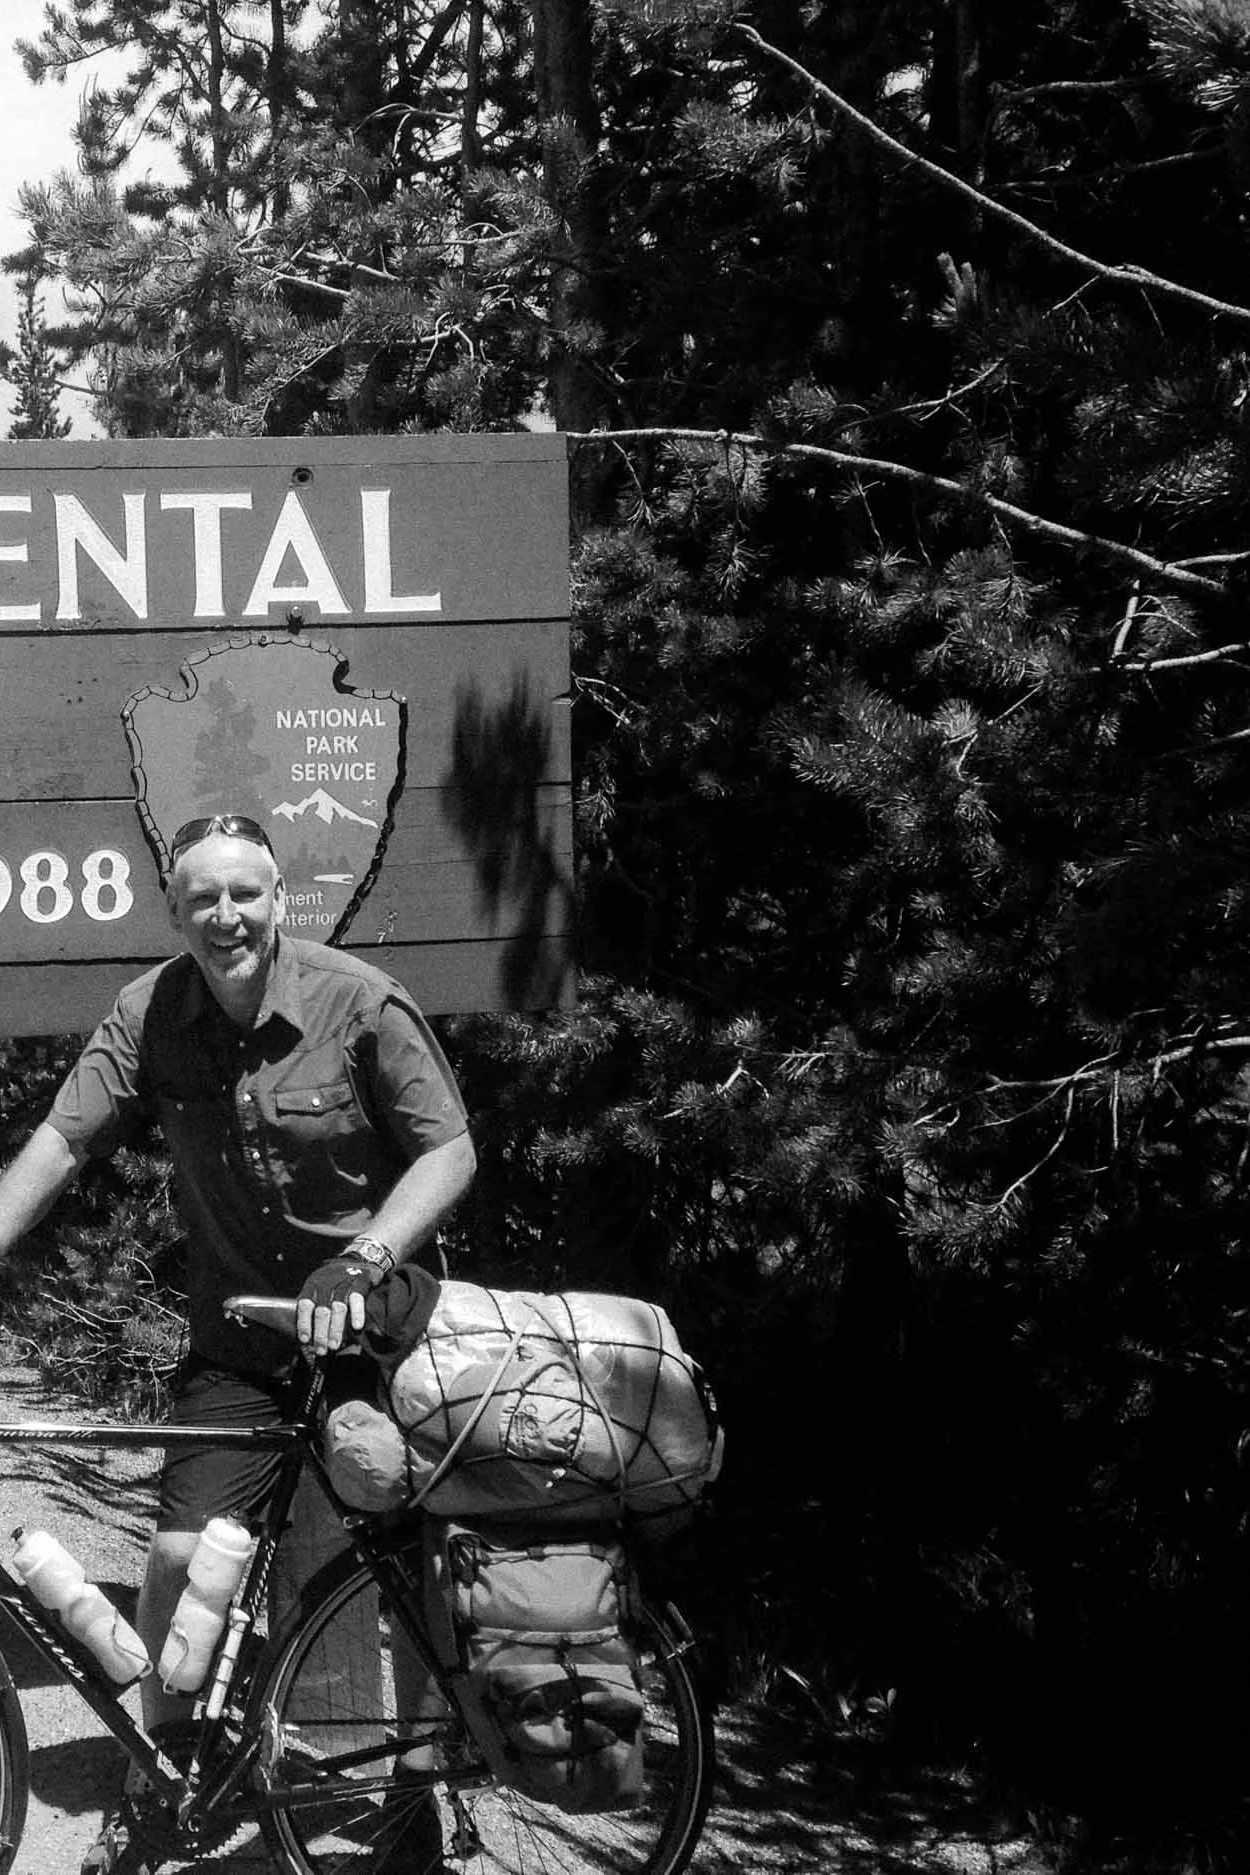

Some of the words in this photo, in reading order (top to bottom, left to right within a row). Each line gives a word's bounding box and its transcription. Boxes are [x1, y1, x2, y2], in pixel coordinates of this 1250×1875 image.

[276, 708, 387, 729] NATIONAL
[306, 735, 359, 755] PARK
[291, 762, 377, 782] SERVICE
